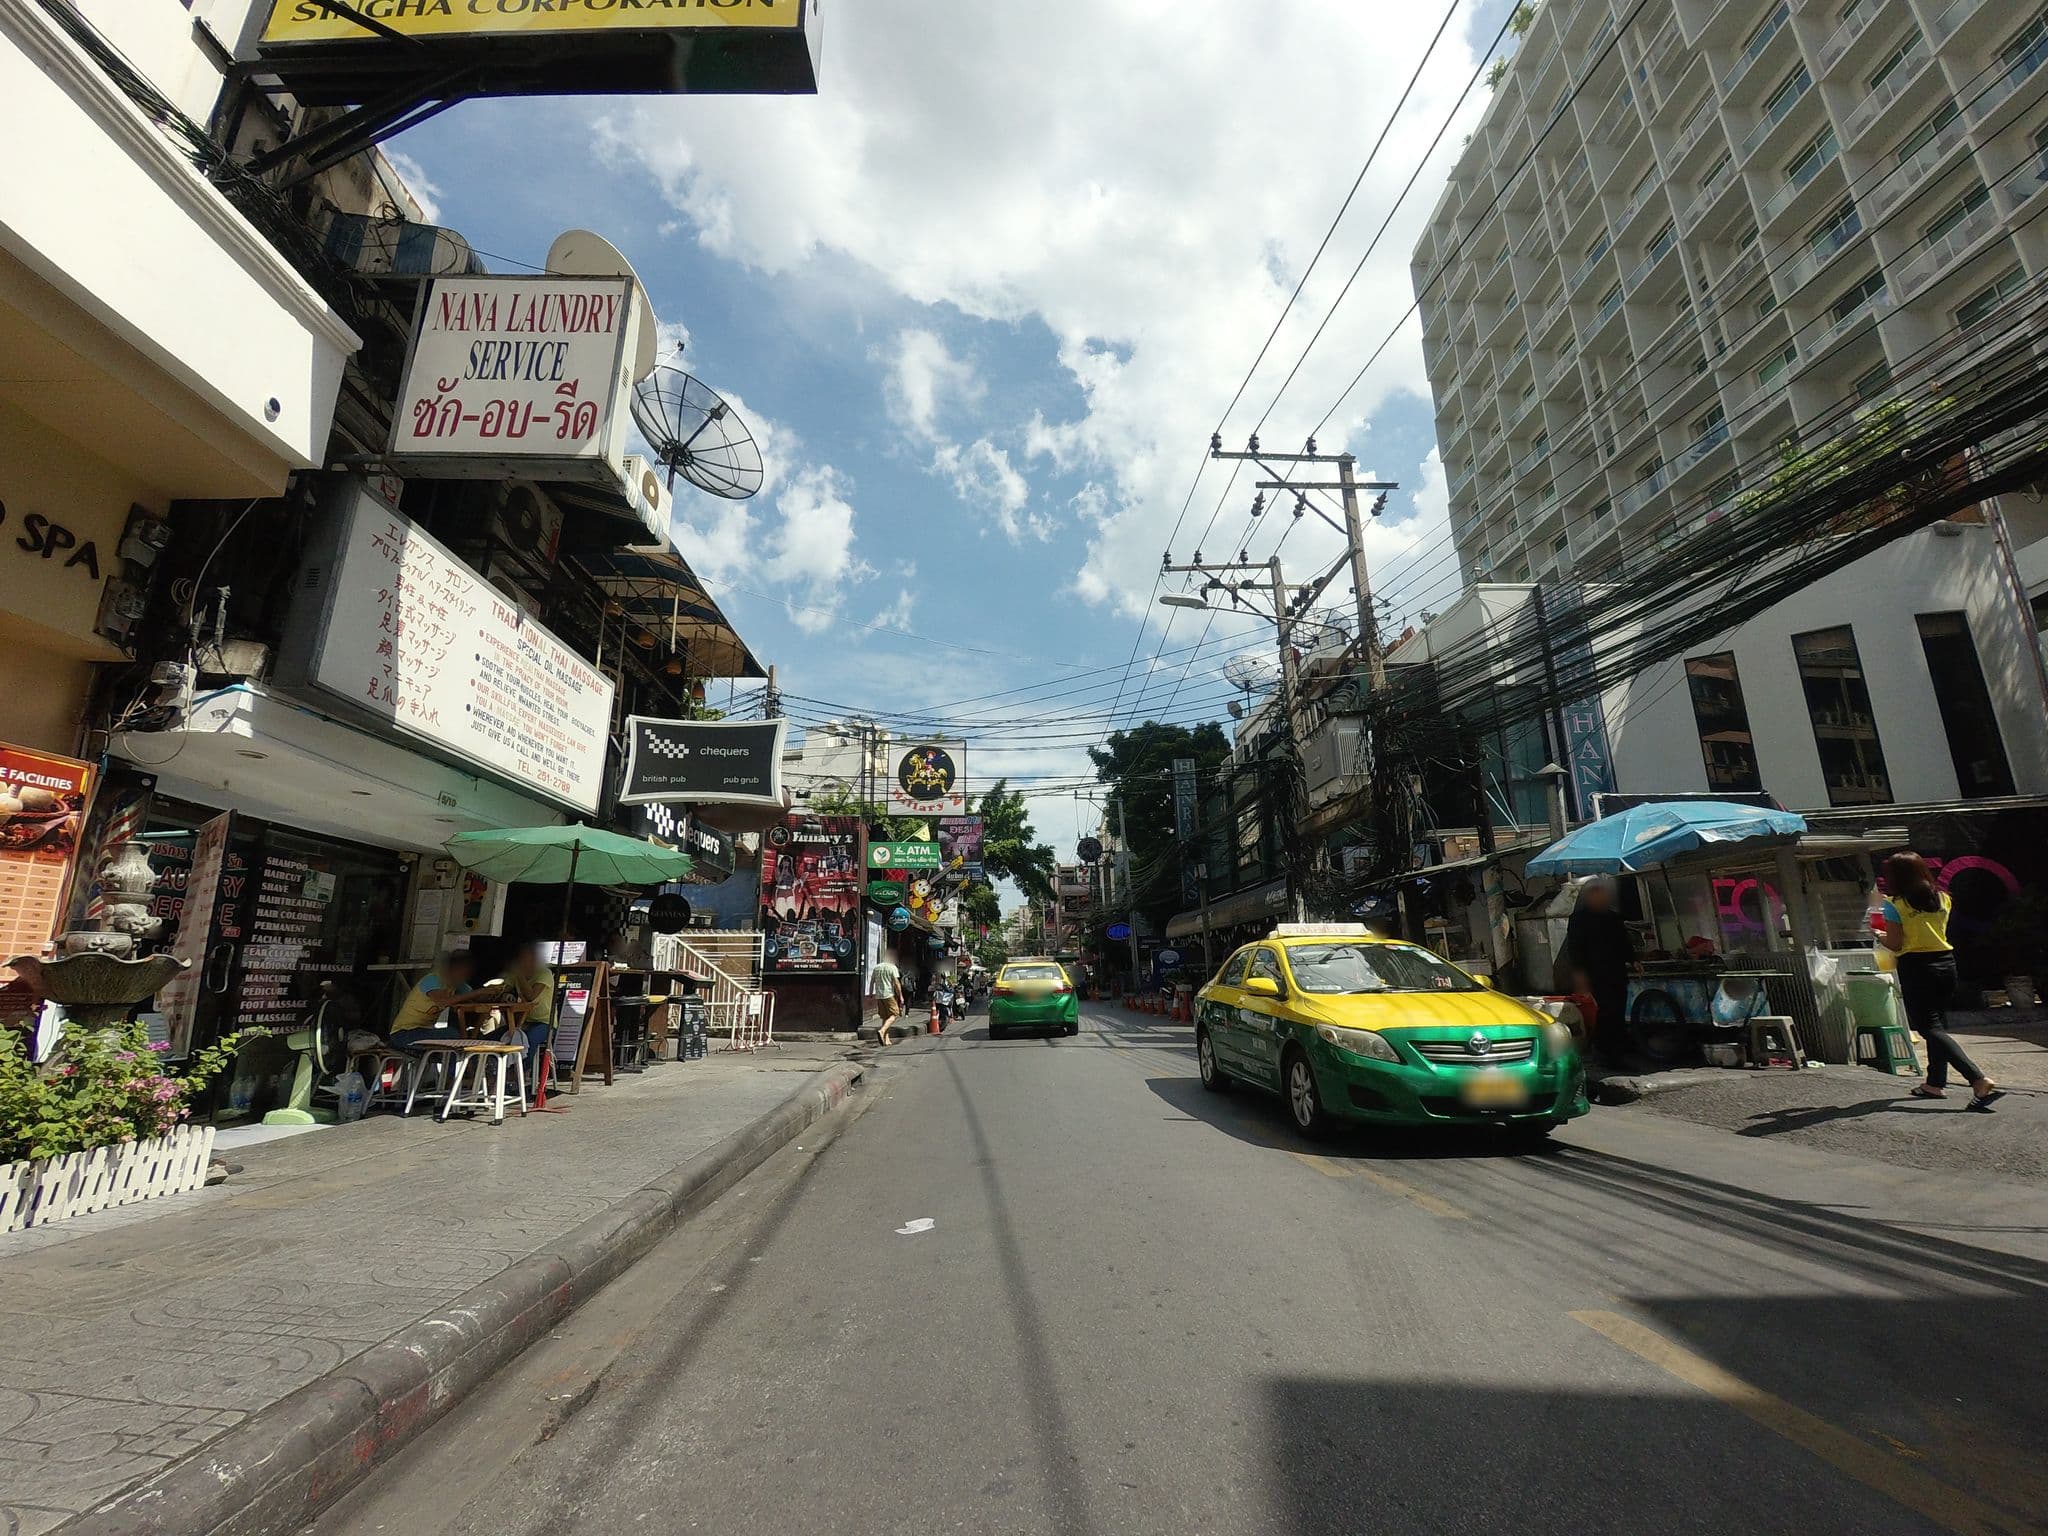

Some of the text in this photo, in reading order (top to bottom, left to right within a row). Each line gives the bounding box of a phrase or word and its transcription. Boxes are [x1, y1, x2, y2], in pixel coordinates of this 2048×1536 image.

[432, 292, 622, 333] NANA LAUNDRY
[464, 340, 569, 382] SERVICE
[16, 514, 100, 580] SPA
[485, 632, 520, 663] EXPERIENCE
[481, 656, 504, 677] SOOTHE
[505, 671, 520, 687] YOUR
[549, 645, 568, 669] THAI
[570, 661, 603, 696] MASSAGE
[477, 681, 489, 695] OUR
[479, 668, 491, 683] AND
[492, 676, 516, 698] RELIEVE
[556, 667, 582, 694] MASSAGE
[475, 693, 487, 708] YOU
[470, 718, 485, 734] JUST
[487, 727, 501, 742] GIVE
[502, 735, 510, 747] US
[516, 743, 529, 757] CALL
[531, 751, 541, 763] AND
[517, 731, 543, 752] WHENEVER
[700, 746, 750, 758] chequers
[8, 768, 73, 791] FACILITIES
[642, 775, 759, 785] british pub pub grub
[1179, 761, 1200, 901] HANRANS
[906, 846, 931, 856] ATM
[266, 856, 308, 872] SHAMPOO
[264, 868, 303, 882] HAIRCUT
[261, 882, 290, 894] SHAVE
[256, 908, 323, 923] HAIR COLORING
[254, 921, 306, 933] PERMANENT
[251, 934, 324, 947] FACIAL MASSAGE
[250, 948, 311, 959] EAR CLEANING
[301, 963, 319, 972] THAI
[320, 964, 352, 972] MASSAGE
[245, 974, 292, 983] MANICURE
[242, 987, 288, 996] PEDICURE
[240, 1000, 308, 1010] FOOT MASSAGE
[238, 1013, 297, 1022] OIL MASSAGE
